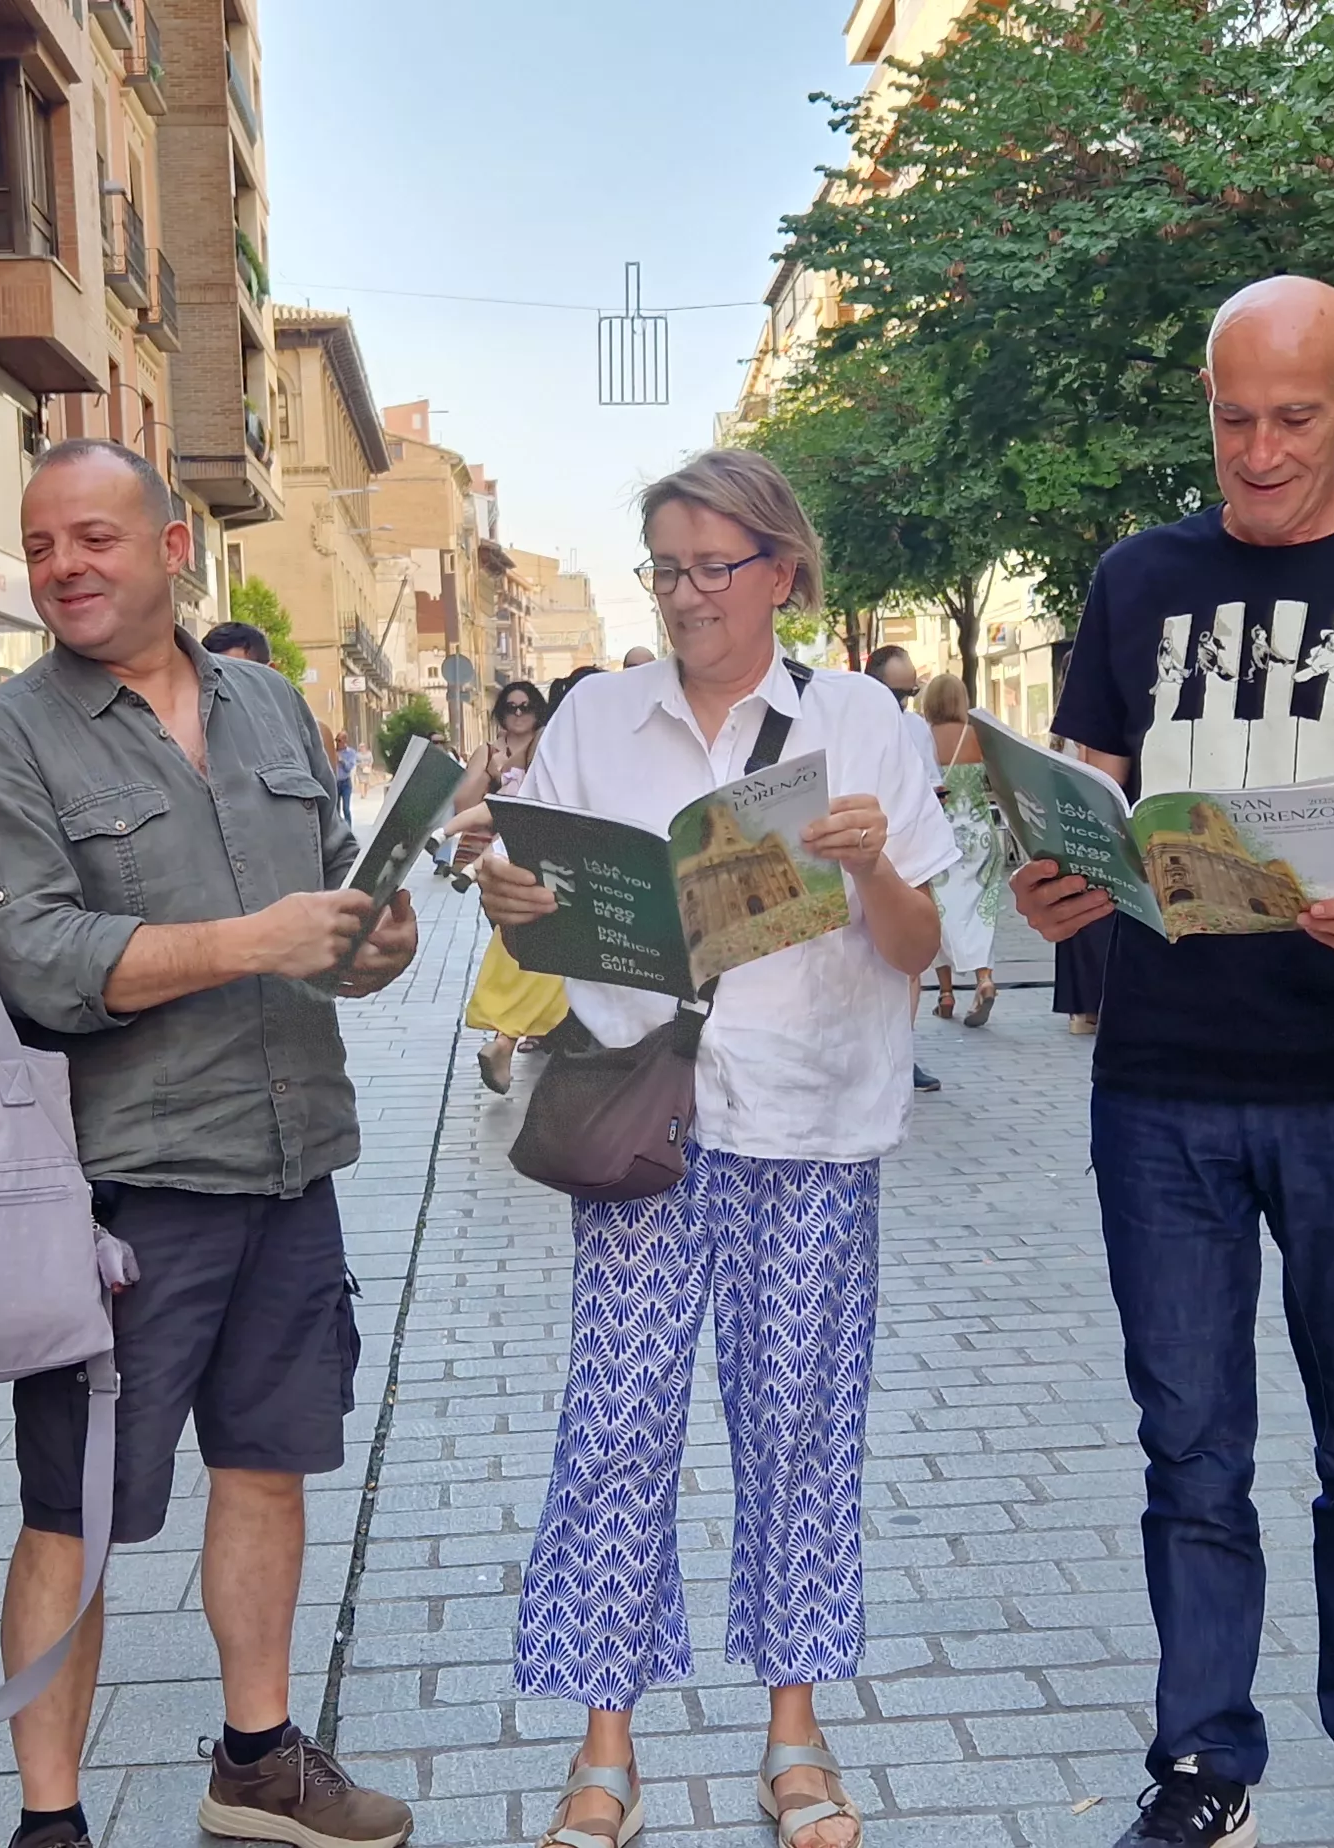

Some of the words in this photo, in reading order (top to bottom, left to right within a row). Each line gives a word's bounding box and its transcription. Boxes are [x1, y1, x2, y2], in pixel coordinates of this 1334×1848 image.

[732, 780, 766, 799] SAN
[734, 770, 818, 812] LORENZO
[1056, 798, 1076, 811] LA
[1230, 798, 1272, 811] SAN
[1308, 797, 1334, 806] 2025
[1057, 806, 1097, 823] LOVE
[1060, 822, 1112, 844] VICCO
[1065, 847, 1085, 858] DE
[1068, 862, 1104, 874] DON
[622, 874, 652, 890] YOU
[1071, 869, 1138, 892] PATRICIO
[589, 880, 635, 902] VICCO
[595, 907, 612, 919] DE
[597, 925, 628, 942] DON
[599, 933, 661, 957] PATRICIO
[601, 961, 665, 982] QUIJANO
